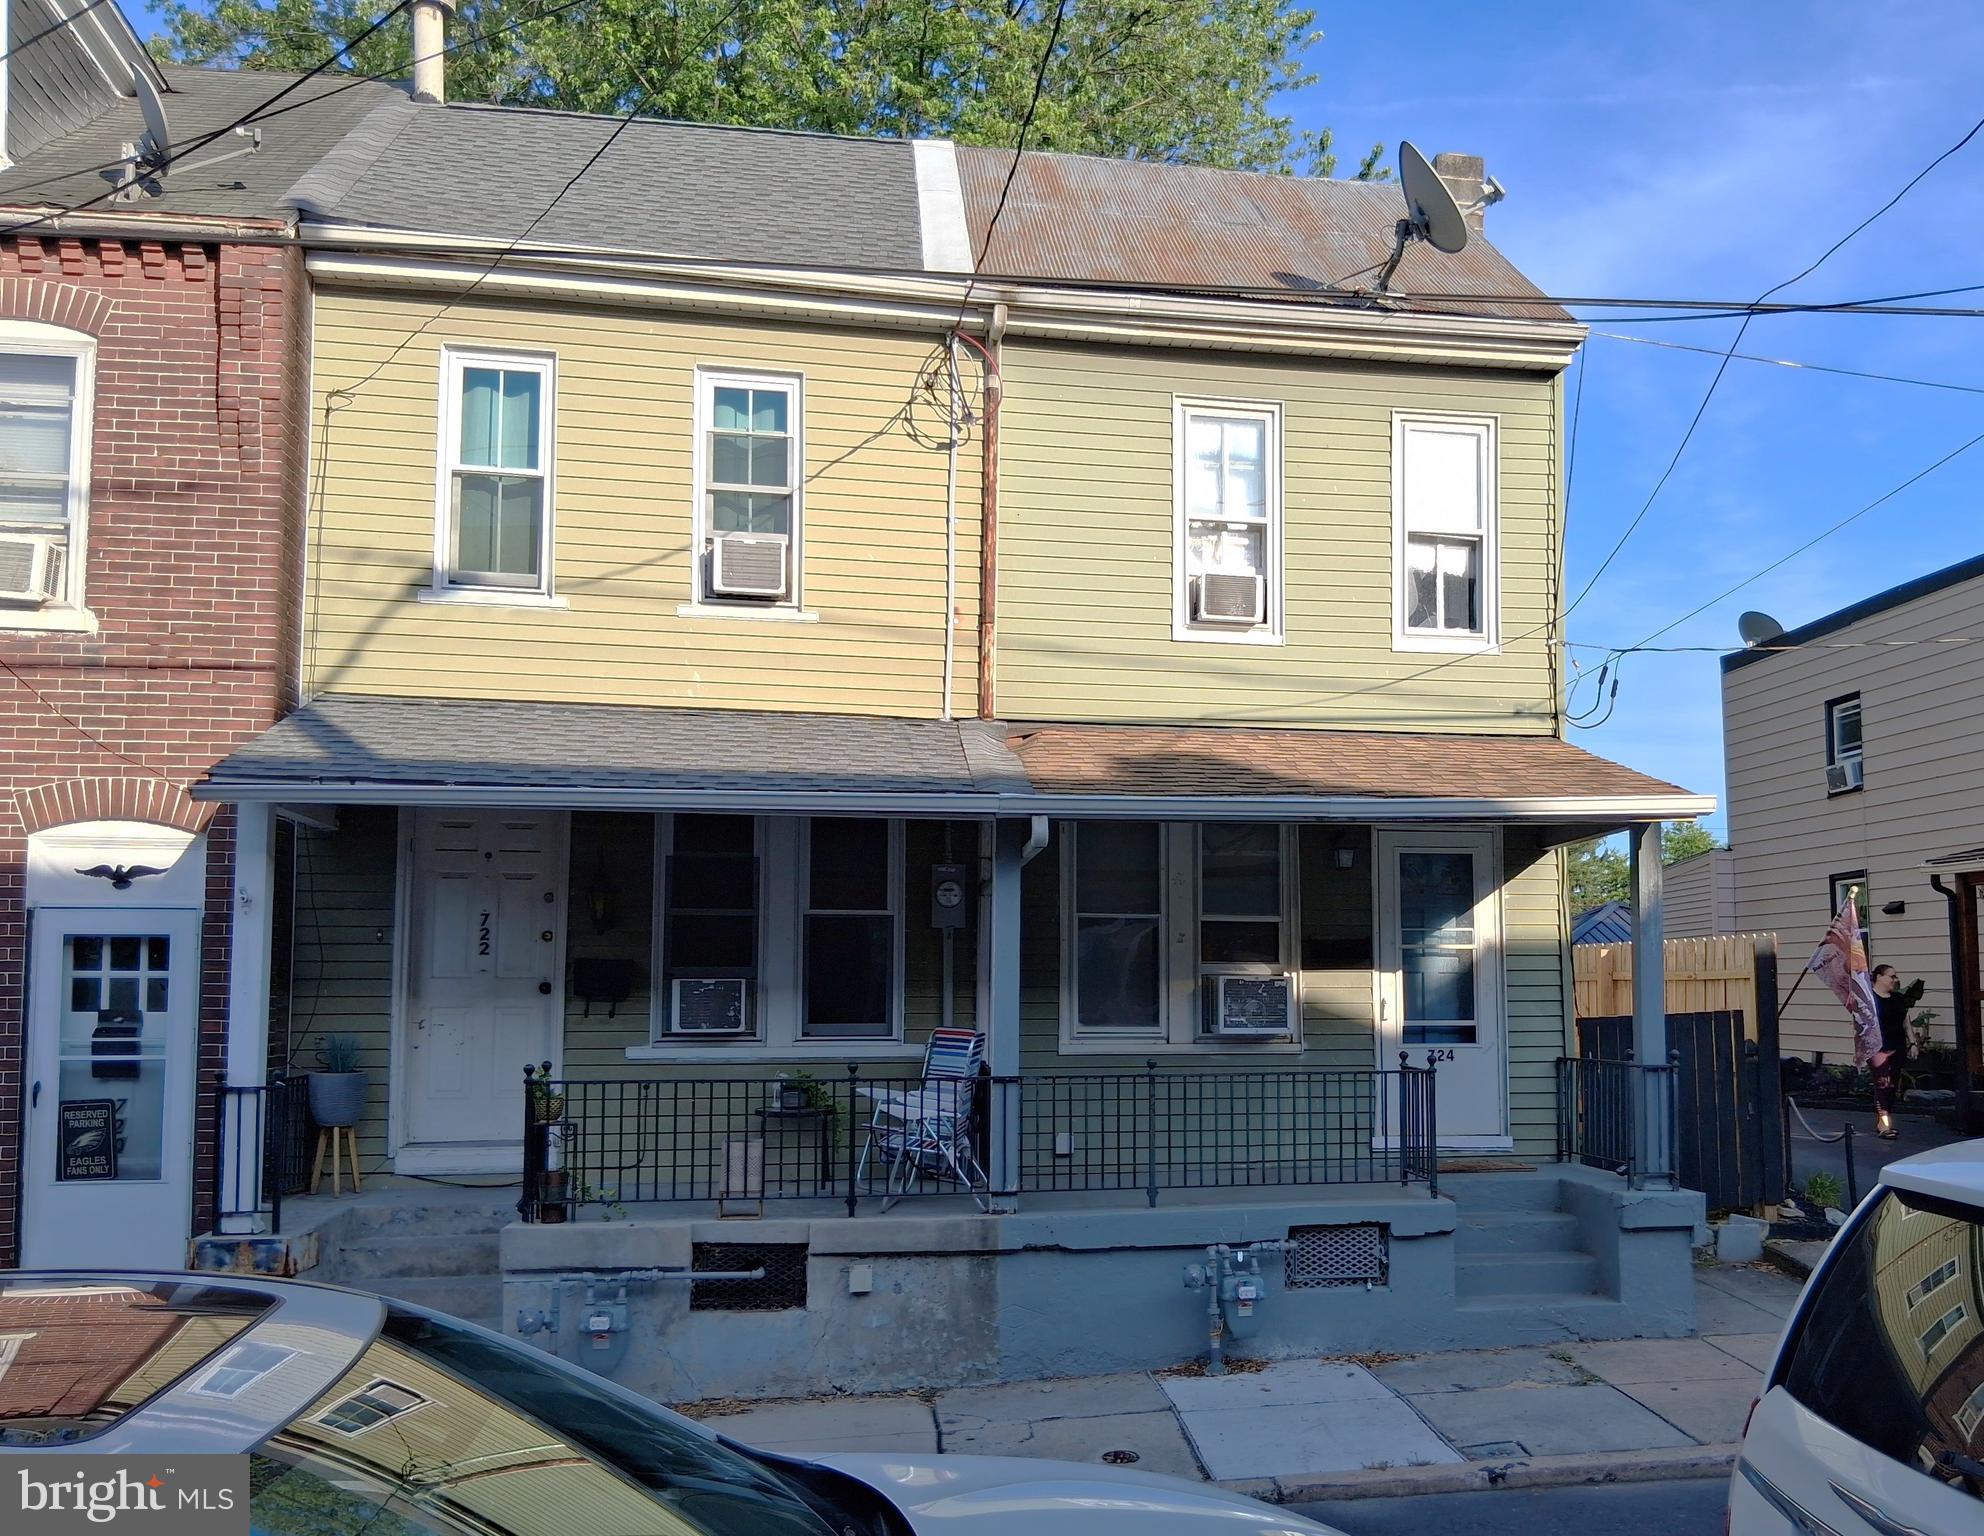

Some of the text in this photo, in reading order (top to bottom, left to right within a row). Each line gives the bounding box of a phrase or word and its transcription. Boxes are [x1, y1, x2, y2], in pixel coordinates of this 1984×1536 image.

[479, 912, 490, 955] 722
[64, 1109, 108, 1120] RESERVED
[69, 1119, 104, 1128] PARKING
[70, 1156, 106, 1166] EAGLES
[66, 1165, 109, 1175] FANS ONLY
